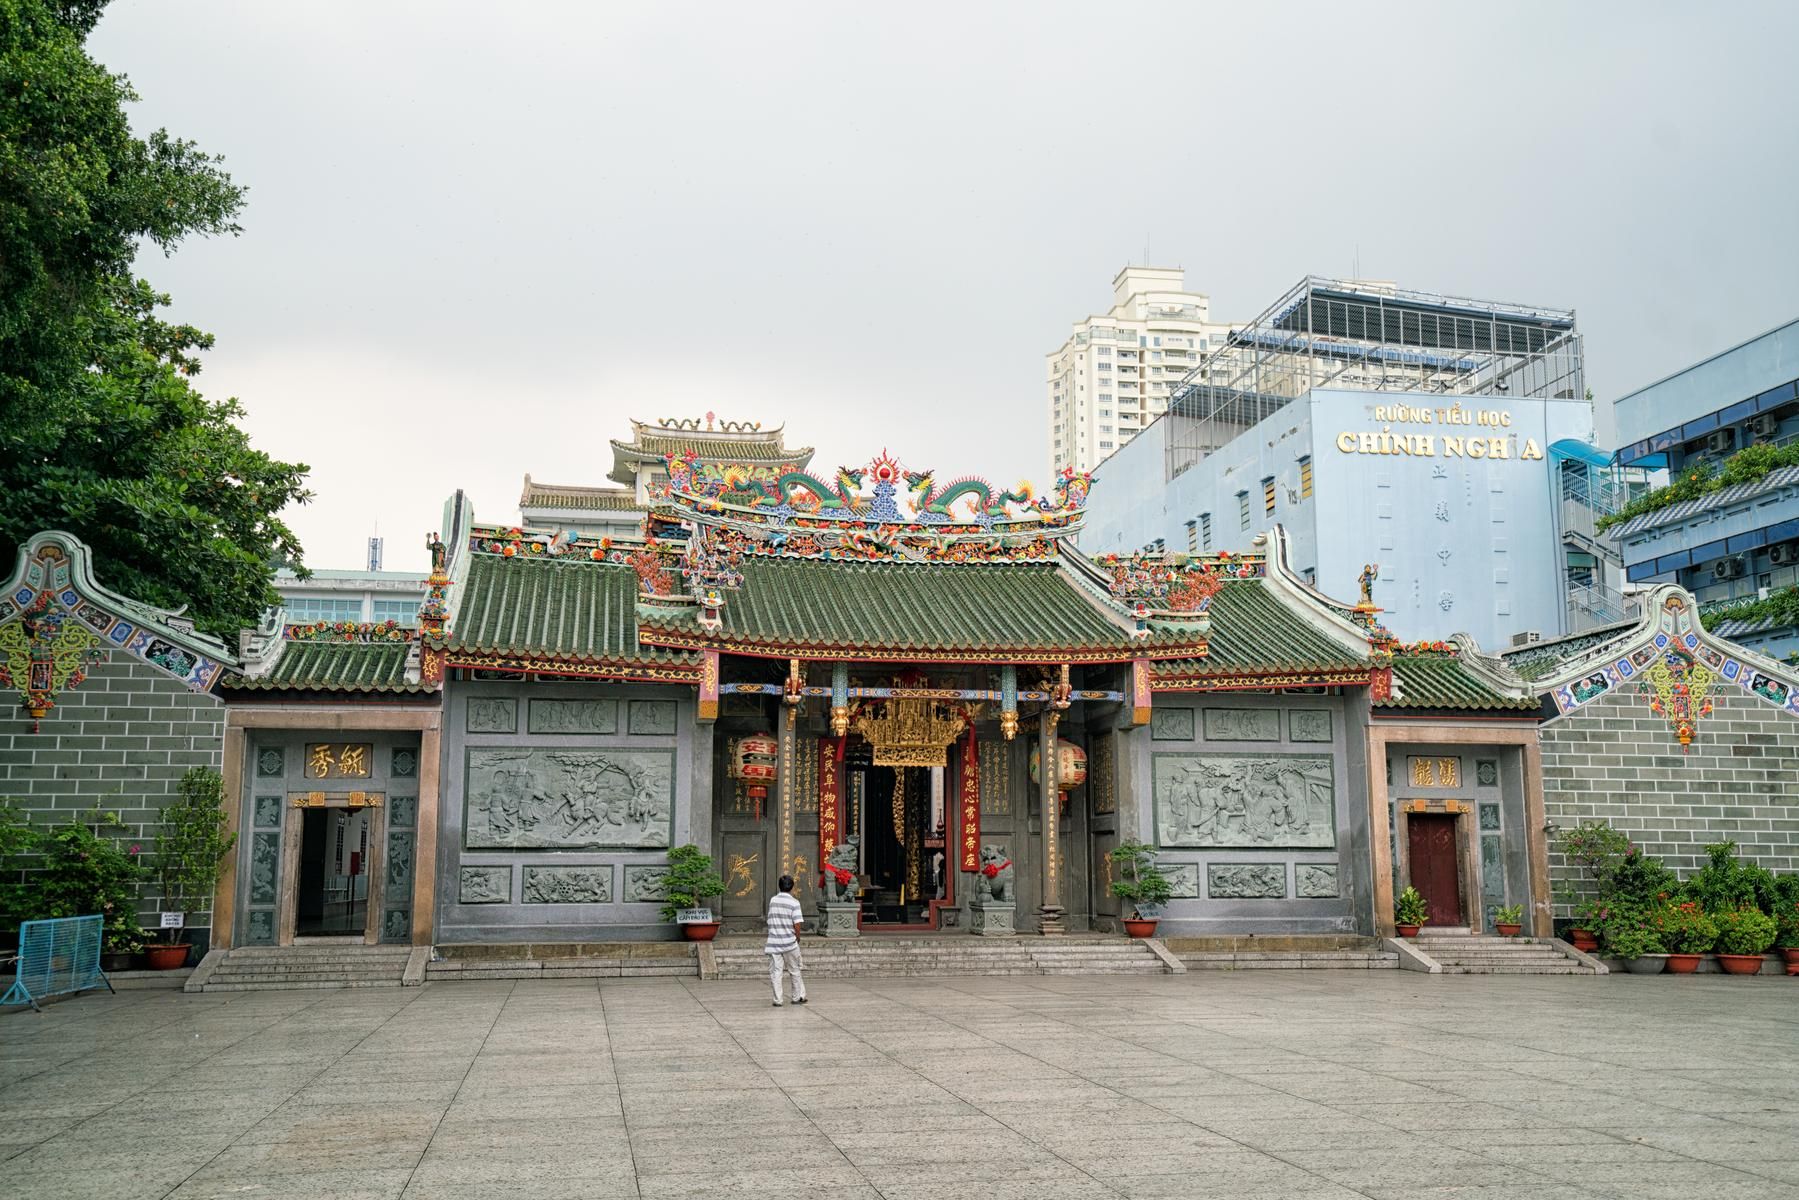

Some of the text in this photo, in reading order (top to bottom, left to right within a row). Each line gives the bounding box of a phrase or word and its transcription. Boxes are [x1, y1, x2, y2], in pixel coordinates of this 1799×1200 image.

[1436, 402, 1472, 426] TIỂU
[1477, 410, 1511, 430] HỌC
[1337, 426, 1436, 456] CHÍNH
